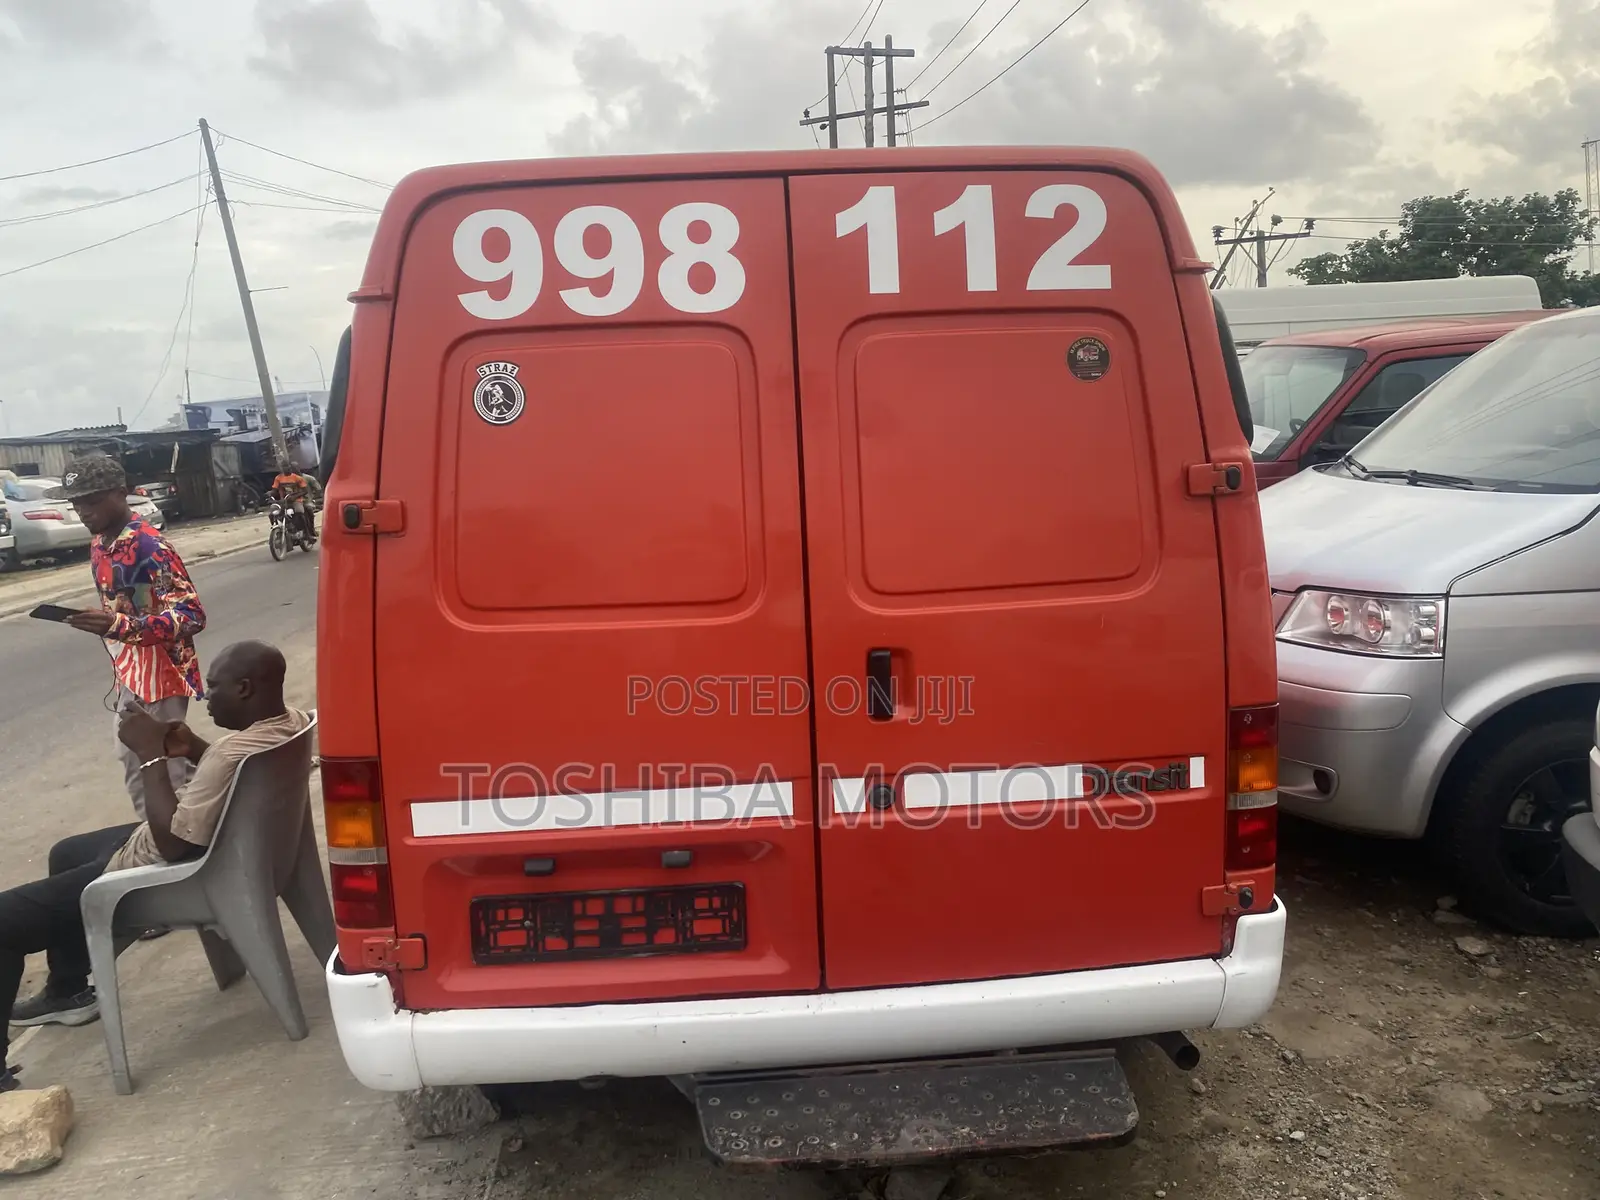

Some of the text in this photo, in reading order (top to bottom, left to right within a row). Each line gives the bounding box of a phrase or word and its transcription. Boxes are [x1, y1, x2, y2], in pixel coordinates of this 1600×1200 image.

[452, 184, 1112, 320] 998 112
[1086, 763, 1190, 795] Transit
